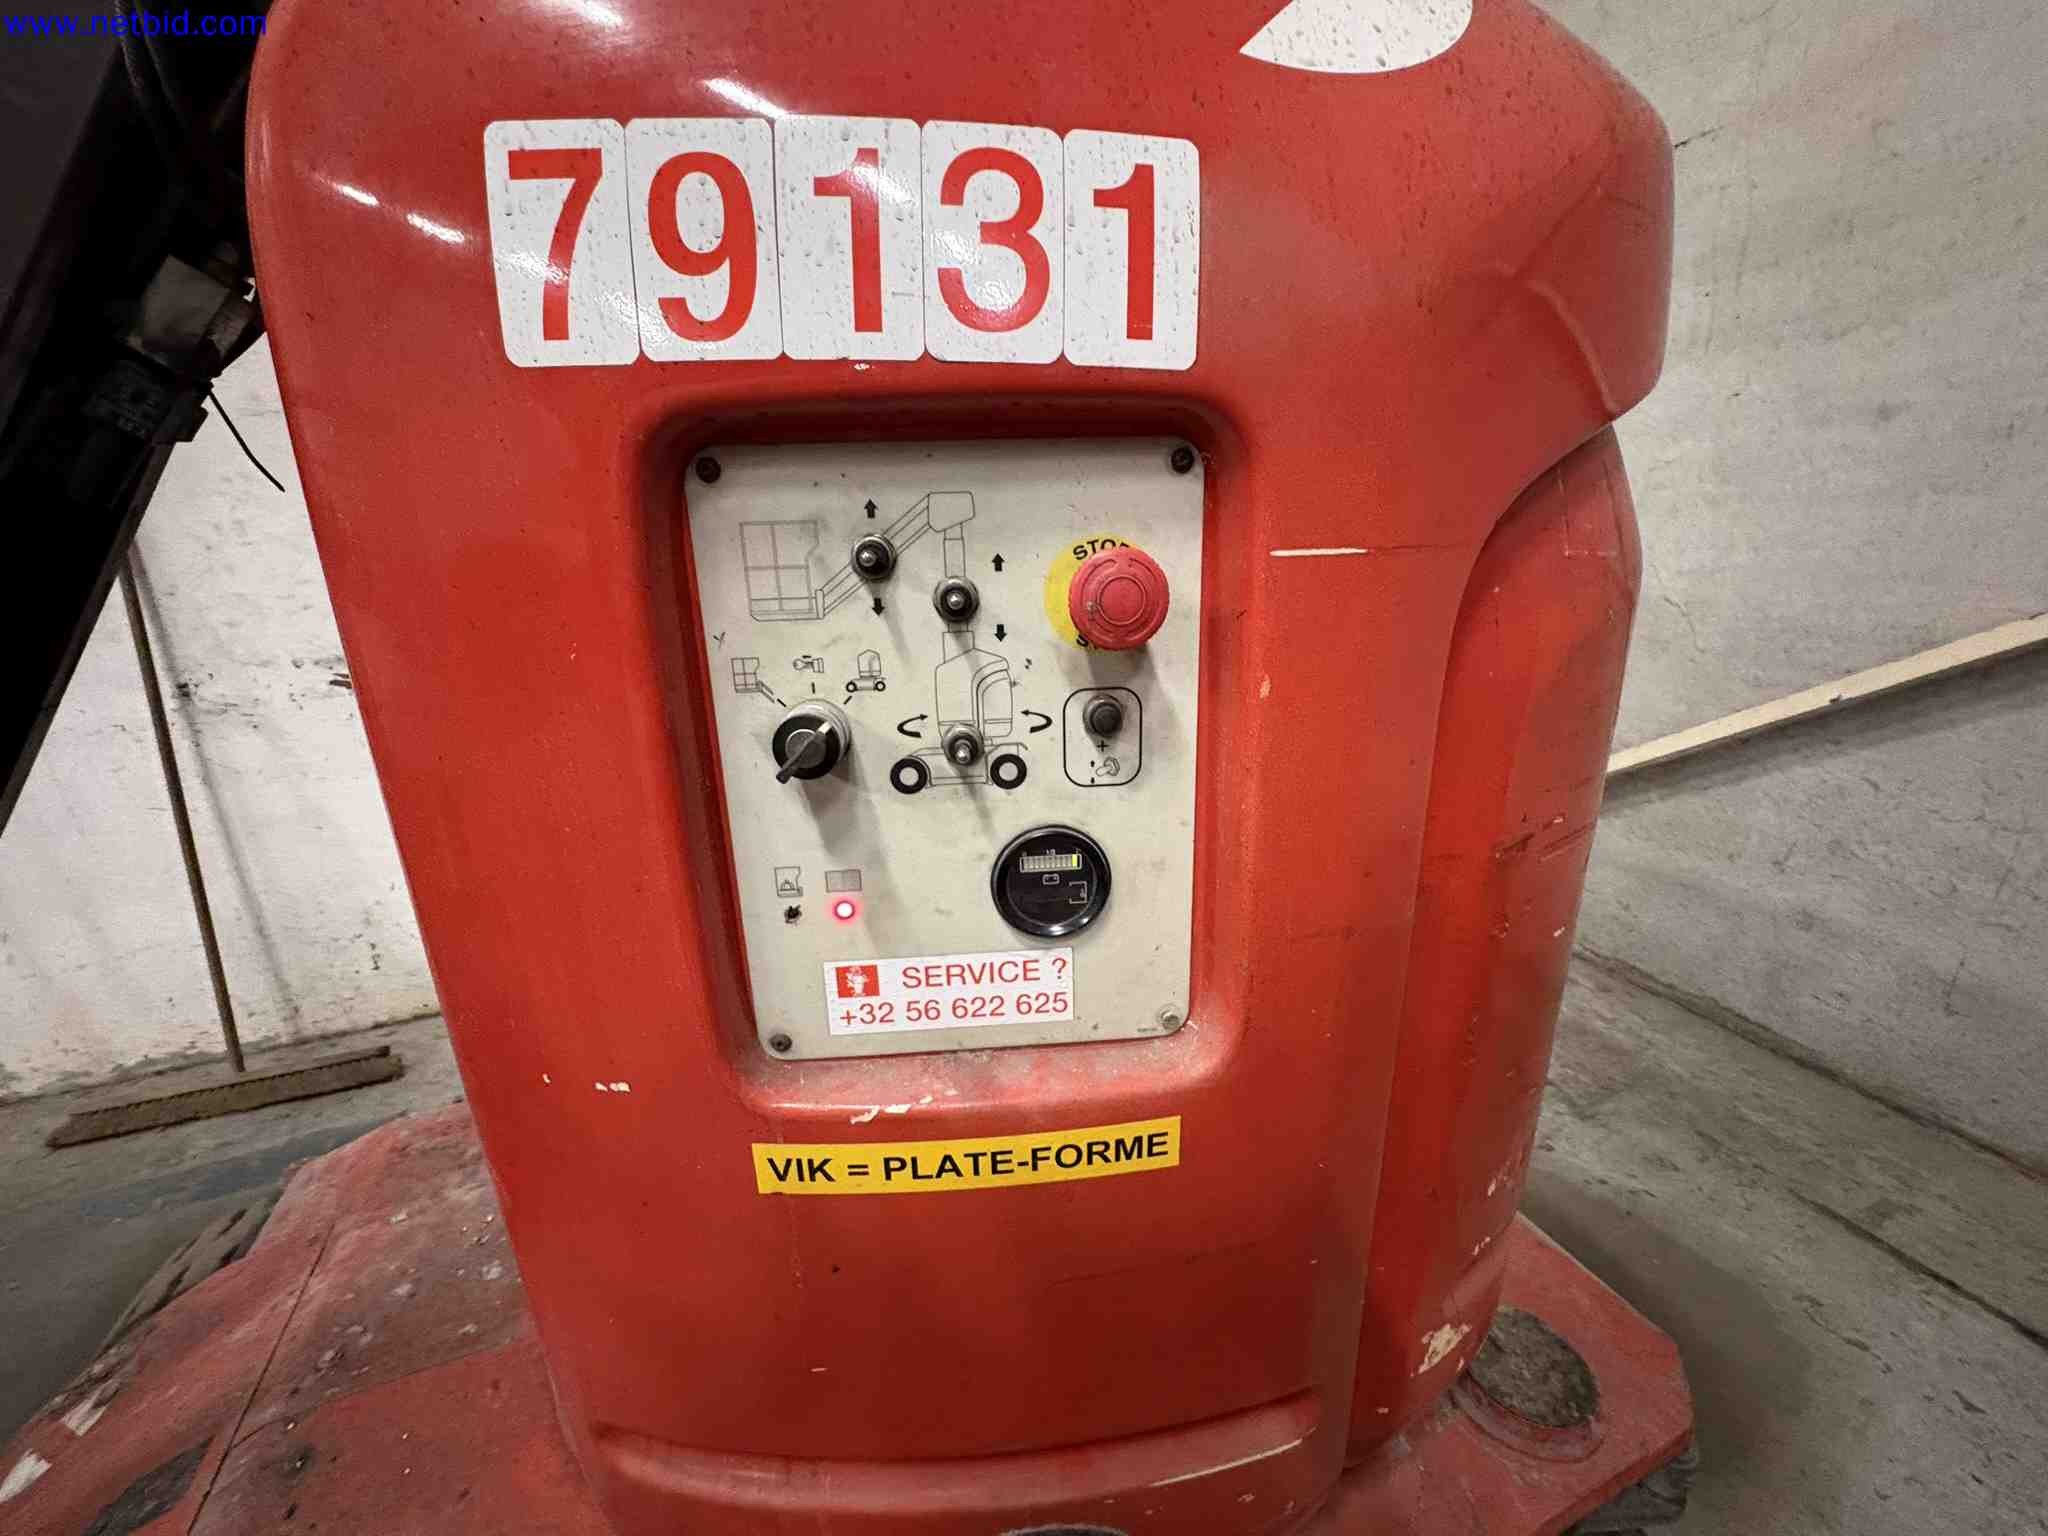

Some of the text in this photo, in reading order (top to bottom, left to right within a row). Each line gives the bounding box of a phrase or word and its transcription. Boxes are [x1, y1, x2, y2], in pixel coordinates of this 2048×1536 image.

[508, 147, 1155, 342] 79131
[1073, 539, 1130, 560] STO
[902, 957, 1067, 989] SERVICE ?
[840, 991, 1069, 1027] +32 56 622 625
[767, 1131, 1170, 1183] VIK = PLATE-FORME
